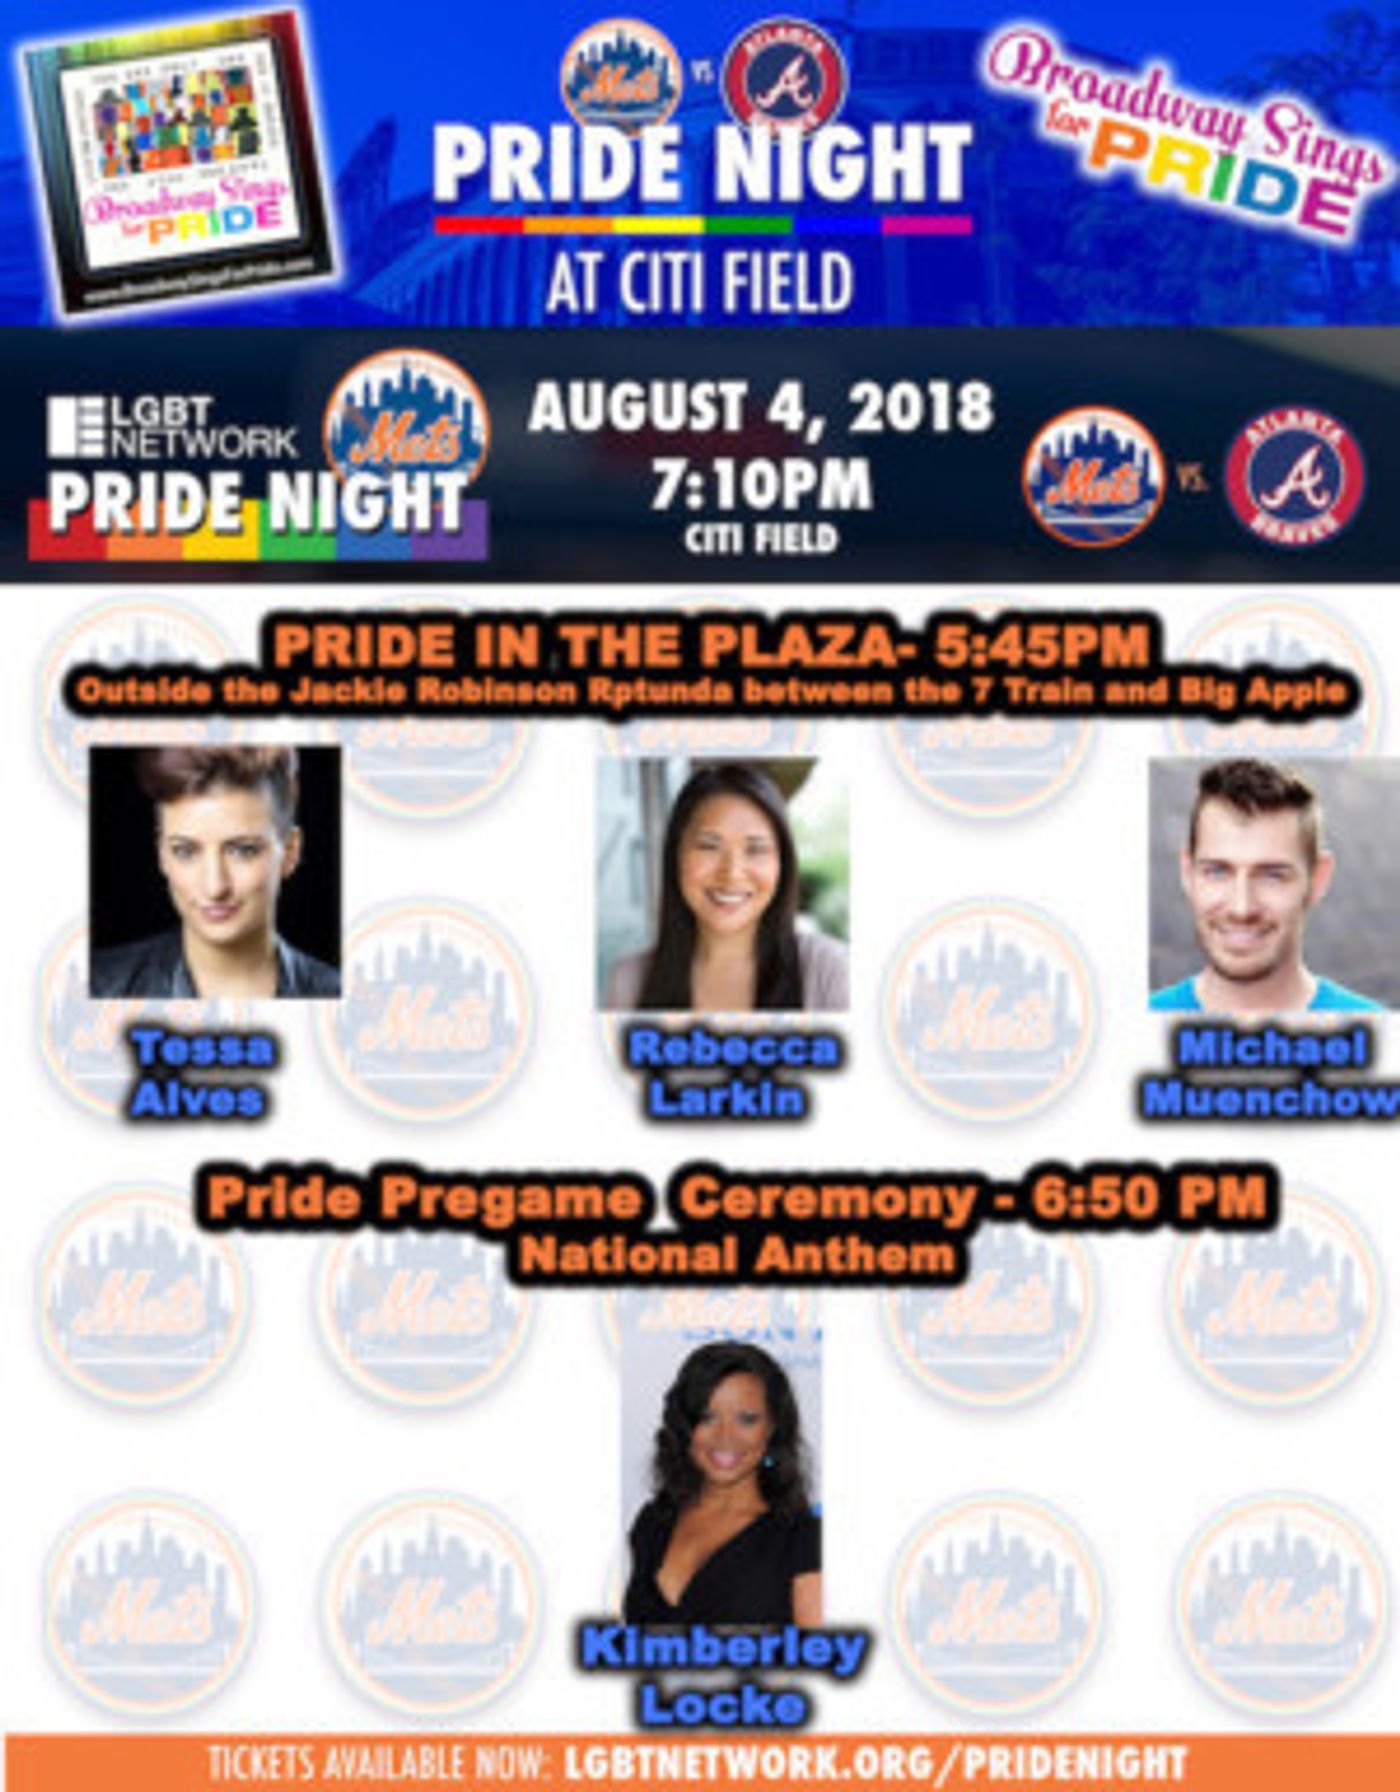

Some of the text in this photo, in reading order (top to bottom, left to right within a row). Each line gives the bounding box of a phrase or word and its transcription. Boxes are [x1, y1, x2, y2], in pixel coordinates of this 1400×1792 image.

[988, 28, 1384, 192] Broadway Sings
[434, 126, 972, 201] PRIDE NIGHT
[1045, 98, 1360, 236] for PRIDE
[148, 200, 282, 244] PRIDE
[547, 251, 853, 312] AT CITI FIELD
[111, 396, 213, 429] LGBT
[528, 381, 994, 444] AUGUST 4, 2018
[111, 429, 299, 458] NETWORK
[350, 410, 462, 465] Mets
[49, 473, 469, 532] PRIDE NIGHT
[652, 458, 873, 510] 7:10PM
[1045, 457, 1141, 505] Mets
[684, 523, 838, 554] CITI FIELD
[274, 625, 1148, 667] PRIDE IN THE PLAZA- 5:45PM
[77, 676, 212, 704] Outside
[223, 676, 279, 704] the
[290, 676, 406, 704] Jackie
[417, 676, 576, 704] Robinson
[744, 676, 893, 704] between
[905, 676, 961, 704] the
[973, 676, 993, 704] 7
[1004, 676, 1093, 704] Train
[1105, 676, 1168, 704] and
[1179, 676, 1235, 709] Big
[1246, 676, 1347, 709] Apple
[131, 1028, 274, 1066] Tessa
[630, 1028, 839, 1066] Rebecca
[1179, 1027, 1367, 1066] Michael
[130, 1080, 264, 1116] Alves
[649, 1080, 804, 1116] Larkin
[1143, 1079, 1400, 1117] Muenchow
[209, 1176, 360, 1219] Pride
[381, 1176, 642, 1229] Pregame
[680, 1176, 977, 1229] Ceremony
[1033, 1176, 1158, 1219] 6:50
[1179, 1176, 1266, 1219] PM
[520, 1236, 955, 1273] National Anthem
[582, 1625, 866, 1676] Kimberley
[641, 1685, 806, 1725] Locke
[208, 1745, 1188, 1789] TICKETS AVAILABLE NOW: LGBTNETWORK.ORG/PRIDENIGHT
